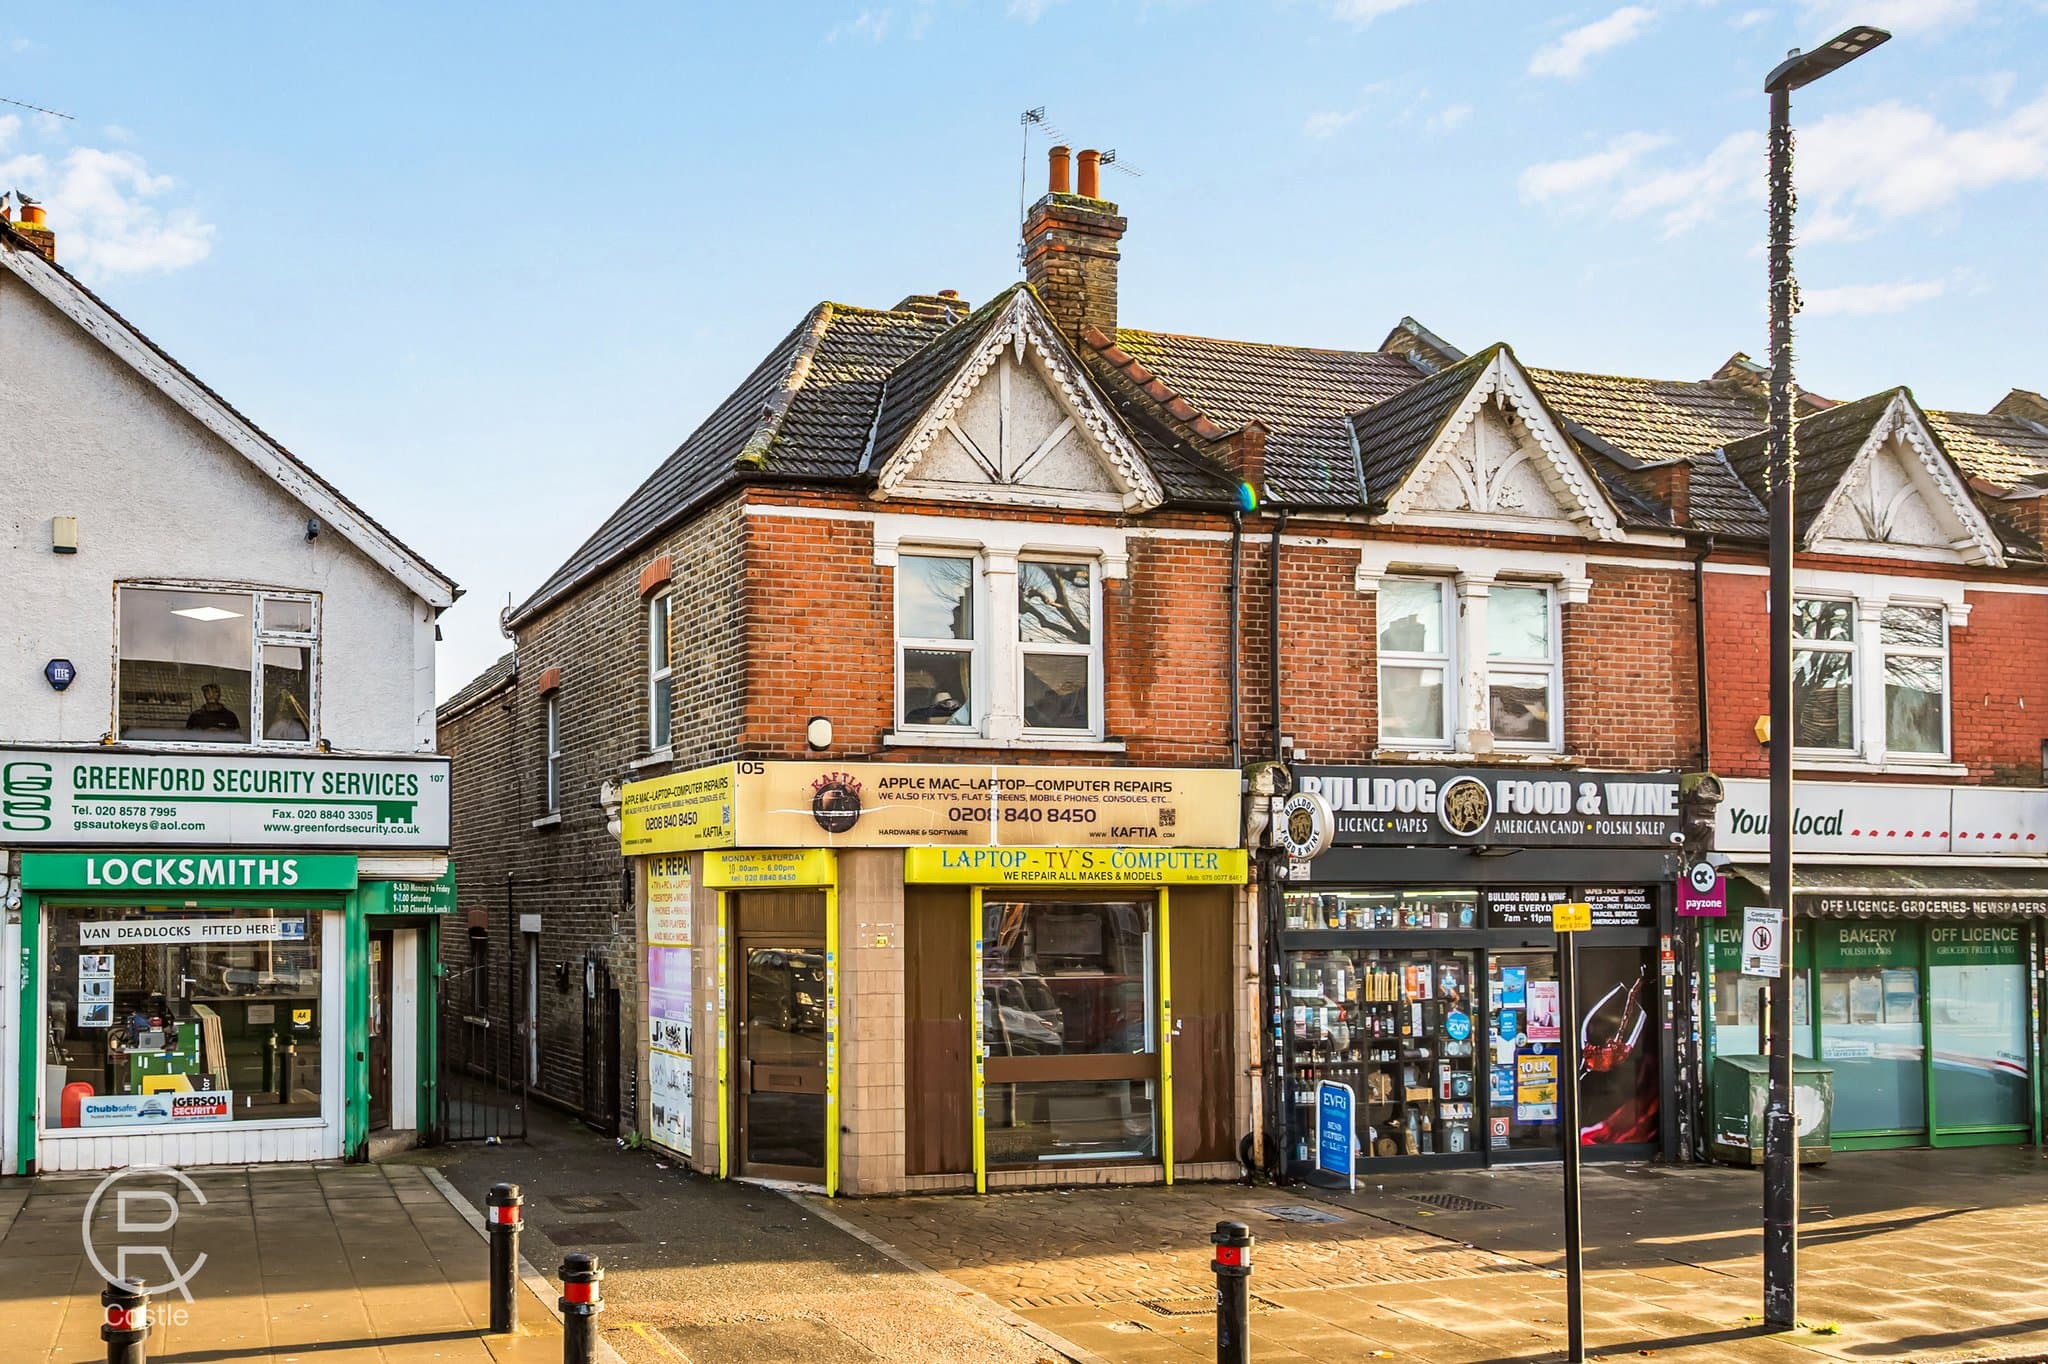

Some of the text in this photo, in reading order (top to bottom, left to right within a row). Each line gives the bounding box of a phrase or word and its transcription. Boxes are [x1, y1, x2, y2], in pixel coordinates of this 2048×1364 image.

[737, 762, 764, 775] 105
[73, 765, 419, 797] GREENFORD SECURITY SERVICES
[430, 775, 444, 783] 107
[704, 777, 728, 791] REPAIRS
[811, 772, 862, 793] KAFTIA
[879, 777, 925, 789] APPLE
[1114, 781, 1173, 793] REPAIRS
[1030, 794, 1062, 802] MOBILE
[1300, 776, 1680, 816] BULLDOG FOOD & WINE
[72, 805, 176, 816] Tel. 020 8578 7995
[272, 809, 373, 820] Fax. 020 8840 3305
[949, 807, 1097, 822] 0208 840 8450
[1284, 800, 1315, 817] BULLDOG
[74, 820, 206, 832] gssautokeys@aol.com
[645, 811, 698, 830] 0208 840 8450
[1338, 818, 1428, 833] LICENCE VAPES
[1730, 808, 1844, 836] You local
[263, 823, 420, 835] www.greenfordsecurity.co.uk
[703, 826, 723, 838] KAFTIA
[1111, 827, 1157, 838] KAFTIA
[1494, 820, 1666, 835] AMERICAN CANDY POLSKI SKLEP
[1281, 830, 1296, 854] FOOD
[1305, 830, 1320, 853] WINE
[942, 850, 1027, 867] LAPTOP
[1111, 852, 1219, 870] COMPUTER
[86, 858, 299, 886] LOCKSMITHS
[650, 858, 663, 876] WE
[1004, 871, 1163, 880] WE REPAIR ALL MAKES & MODELS
[411, 894, 431, 904] Saturday
[1488, 892, 1520, 901] BULLDOG
[1521, 892, 1540, 901] FOOD
[1541, 893, 1547, 901] &
[1493, 904, 1552, 912] OPEN EVERYD
[1686, 899, 1722, 910] payzone
[1821, 901, 1843, 912] OFF
[1973, 902, 2047, 914] NEWSPAPERS
[1504, 914, 1521, 922] 7am
[1531, 914, 1551, 923] 11pm
[1747, 916, 1766, 924] Drinking
[84, 923, 276, 939] VAN DEADLOCKS FITTED HERE
[1840, 929, 1897, 943] BAKERY
[1931, 928, 2019, 942] OFF LICENCE
[1723, 948, 1738, 957] TOP
[1841, 946, 1893, 956] POLISH FOODS
[1449, 1023, 1469, 1031] ZYN
[1520, 1061, 1552, 1073] 10 UK
[86, 1104, 137, 1113] Chubbsafes
[173, 1106, 217, 1115] SECURITY
